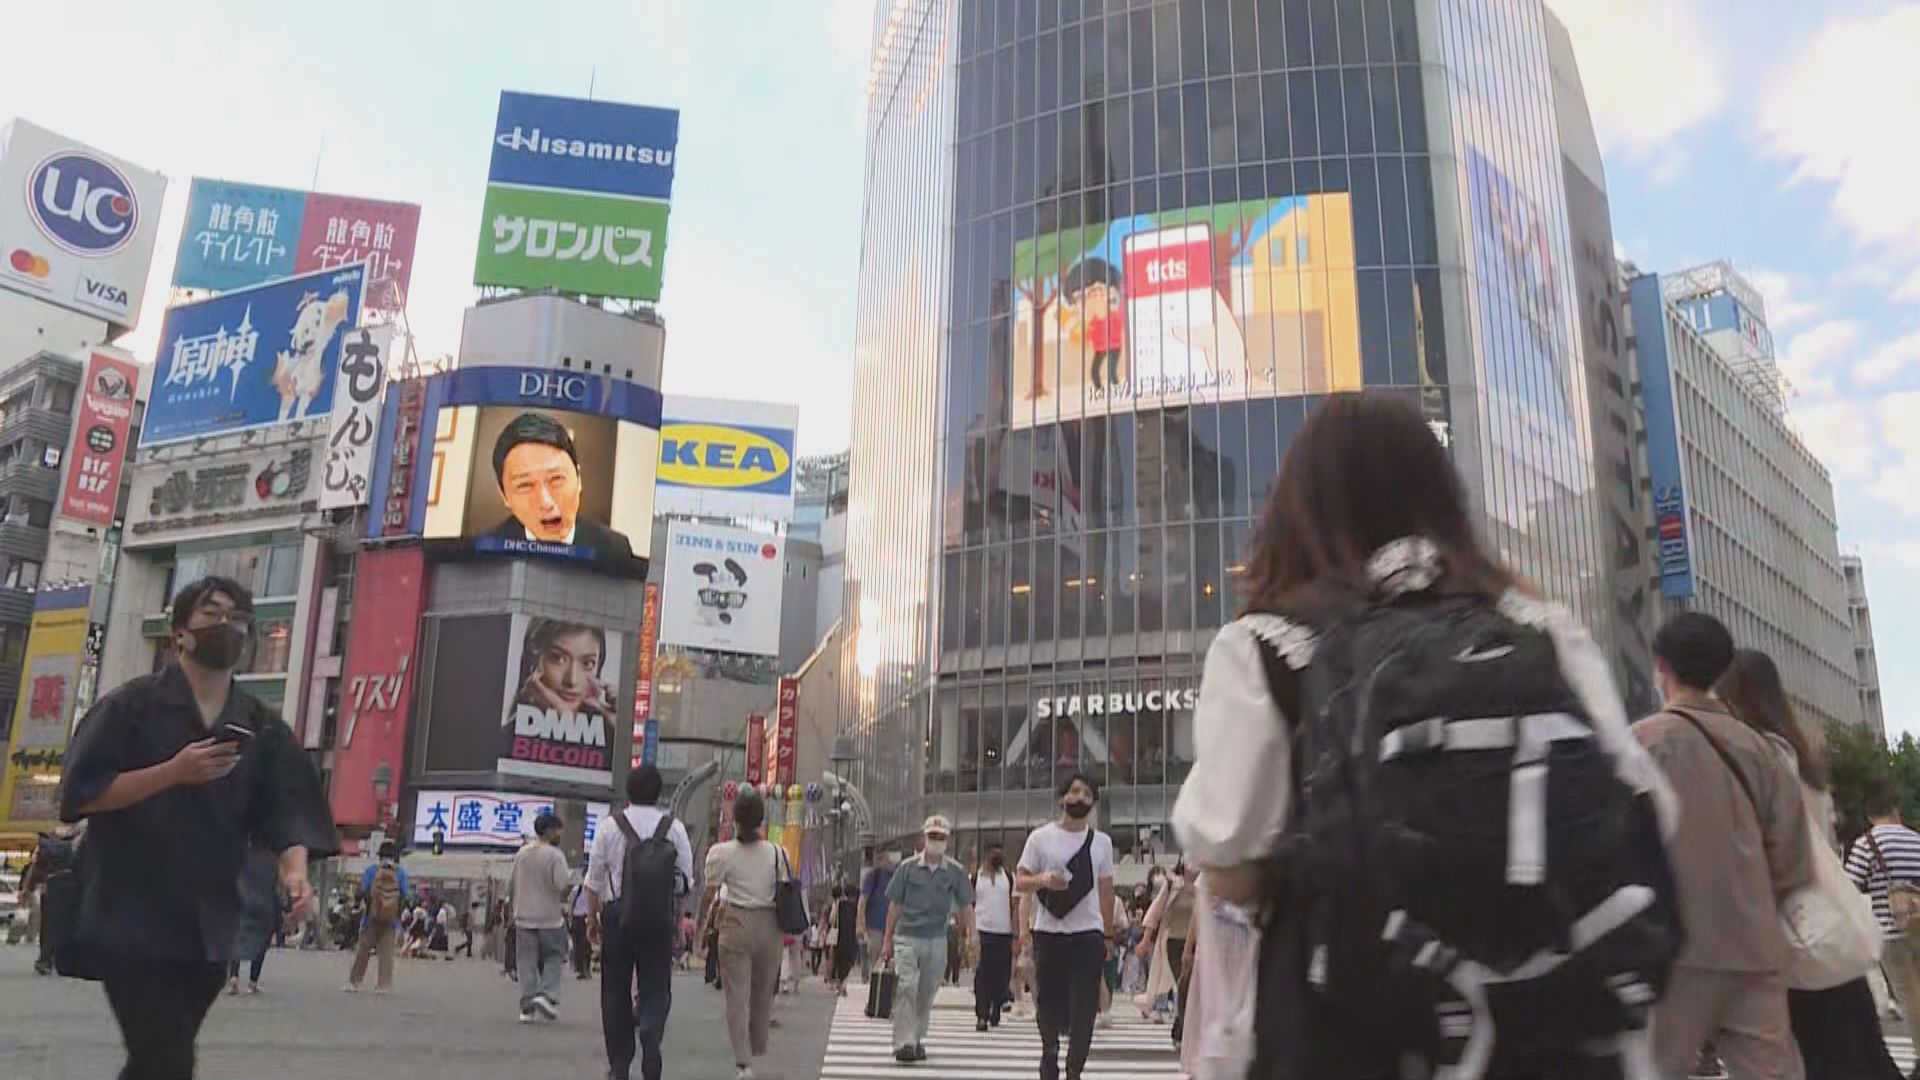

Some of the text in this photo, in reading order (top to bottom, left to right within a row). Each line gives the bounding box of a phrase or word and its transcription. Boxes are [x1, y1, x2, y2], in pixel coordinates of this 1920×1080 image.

[497, 126, 672, 166] Hisamitsu
[208, 203, 280, 237] 龍角散
[327, 216, 395, 250] 龍角散
[195, 230, 287, 266] ダイレクト
[493, 214, 653, 268] サロンパス
[1145, 256, 1187, 283] tkts
[86, 278, 128, 306] VISA
[164, 303, 259, 404] 原神
[519, 372, 586, 401] DHC
[325, 327, 383, 501] もんじゃ
[661, 438, 777, 472] KEA
[503, 538, 528, 551] DHC
[342, 655, 409, 748] クスリ
[1037, 689, 1199, 718] STARBUCKS
[514, 704, 606, 748] DMM
[512, 734, 604, 769] Bitcoin
